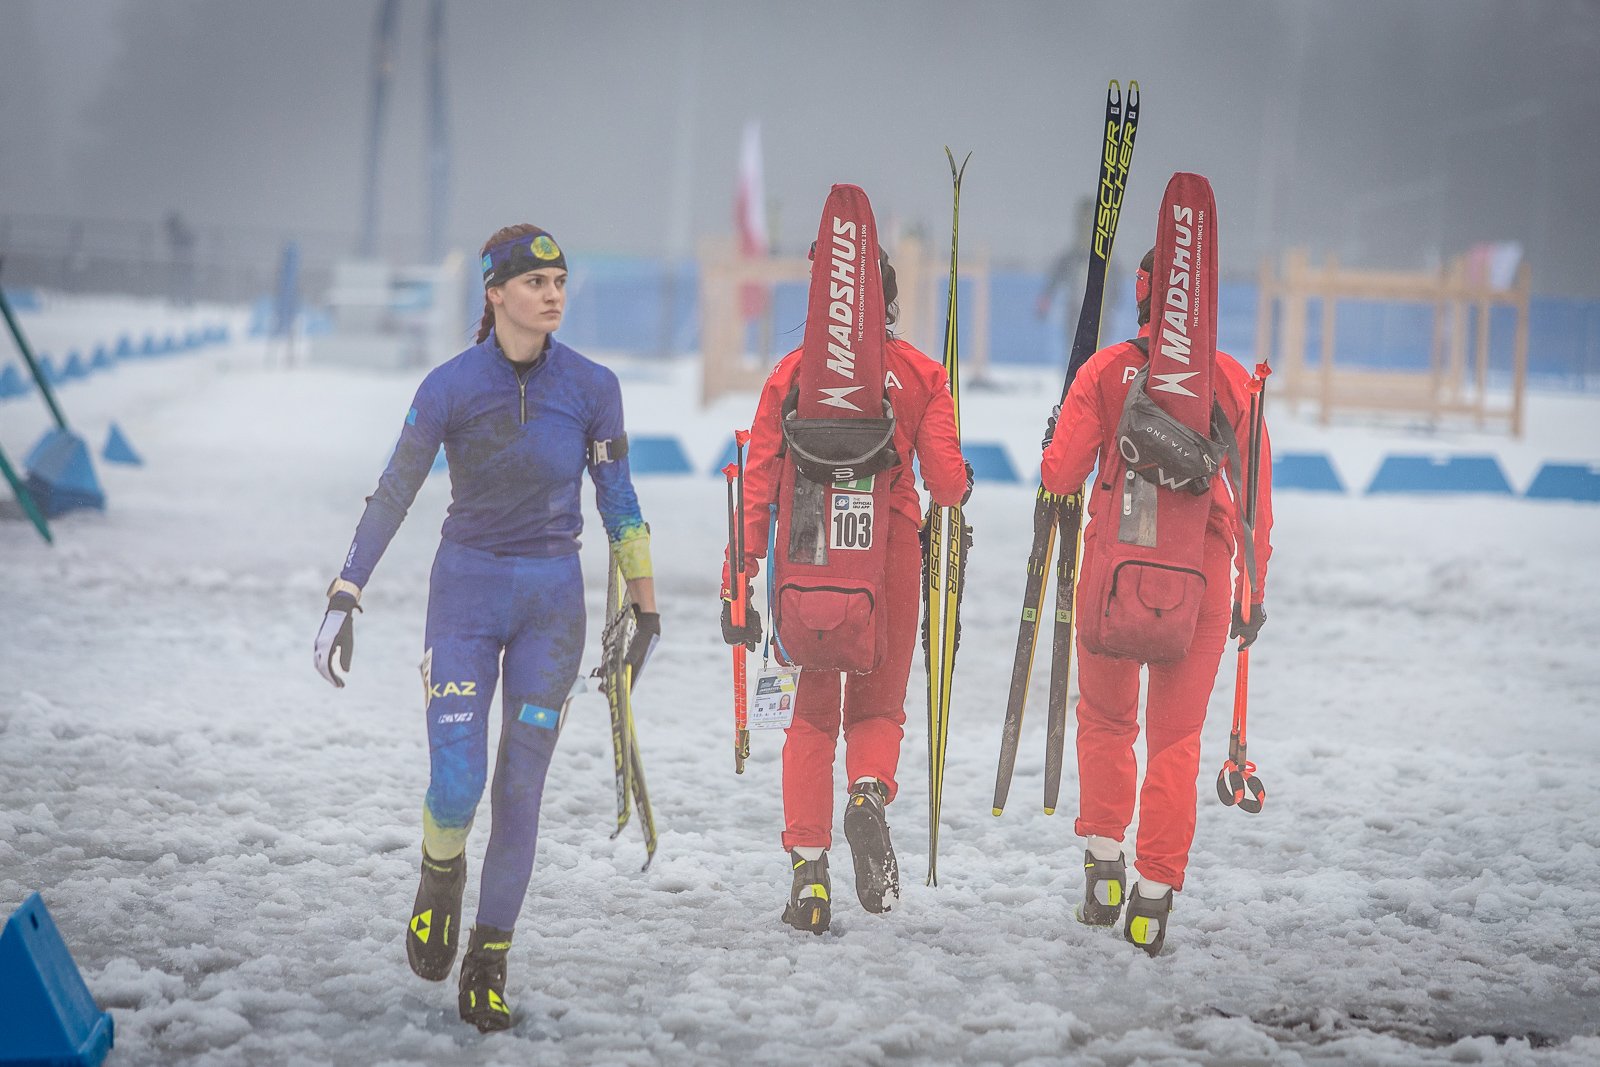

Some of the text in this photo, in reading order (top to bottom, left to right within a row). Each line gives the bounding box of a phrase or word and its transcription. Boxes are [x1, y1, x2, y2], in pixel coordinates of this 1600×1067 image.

[1095, 120, 1120, 260] FISCHER
[827, 216, 857, 380] MADSHUS
[1161, 205, 1193, 365] MADSHUS
[1146, 426, 1190, 457] ONE WAY
[833, 512, 872, 548] 103
[931, 502, 942, 591] FISCHER
[949, 505, 960, 594] FISCHER
[430, 681, 477, 699] KAZ
